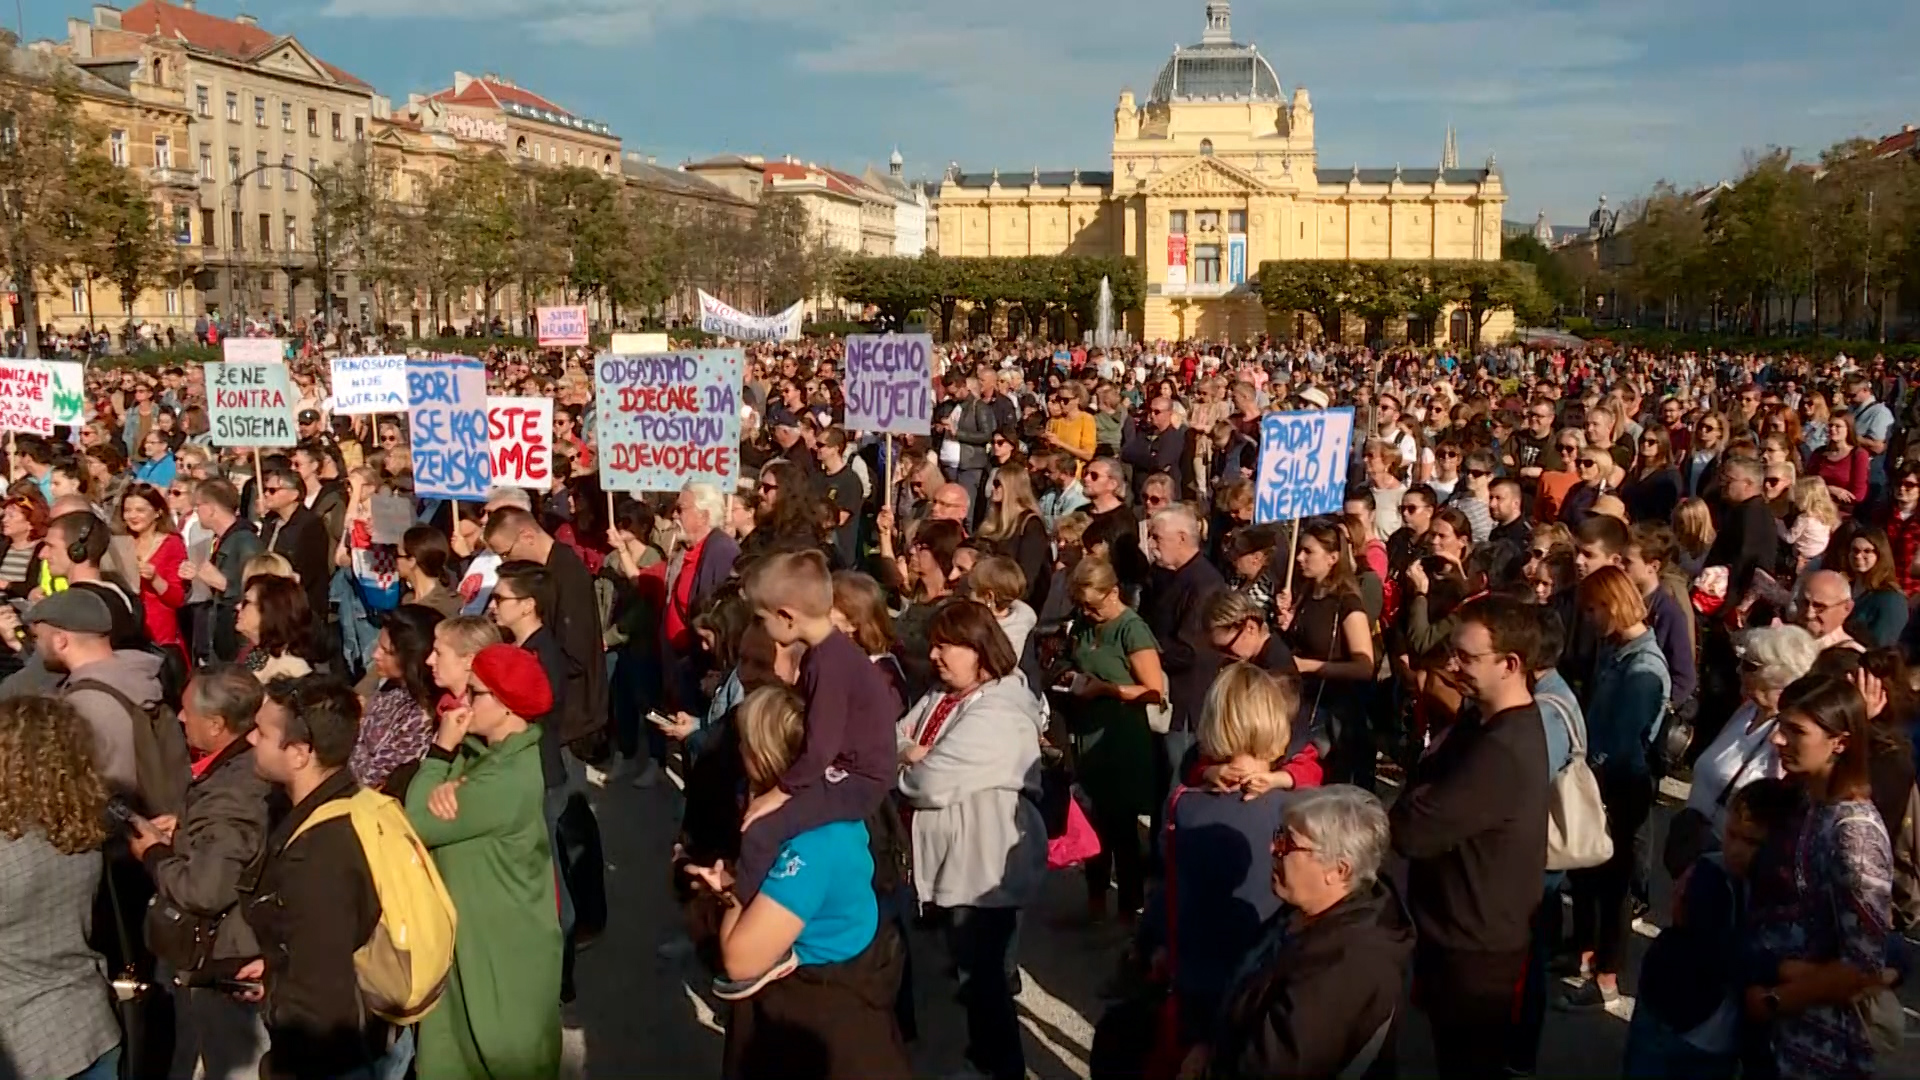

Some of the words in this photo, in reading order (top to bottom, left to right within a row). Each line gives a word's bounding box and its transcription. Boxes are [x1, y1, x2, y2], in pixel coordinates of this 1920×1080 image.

[214, 364, 267, 386] ŽENE
[351, 375, 382, 387] NIJE
[600, 355, 698, 388] ODGAJAMO
[16, 383, 43, 402] SVE
[216, 387, 286, 408] KONTRA
[336, 391, 404, 408] LUTRIJA
[705, 384, 735, 415] DA
[216, 415, 289, 438] SISTEMA
[413, 409, 448, 447] SE
[450, 409, 487, 449] KAO
[1261, 417, 1325, 457] PADAJ
[609, 440, 730, 476] DJEVOJČICE
[1269, 454, 1320, 490] SILO
